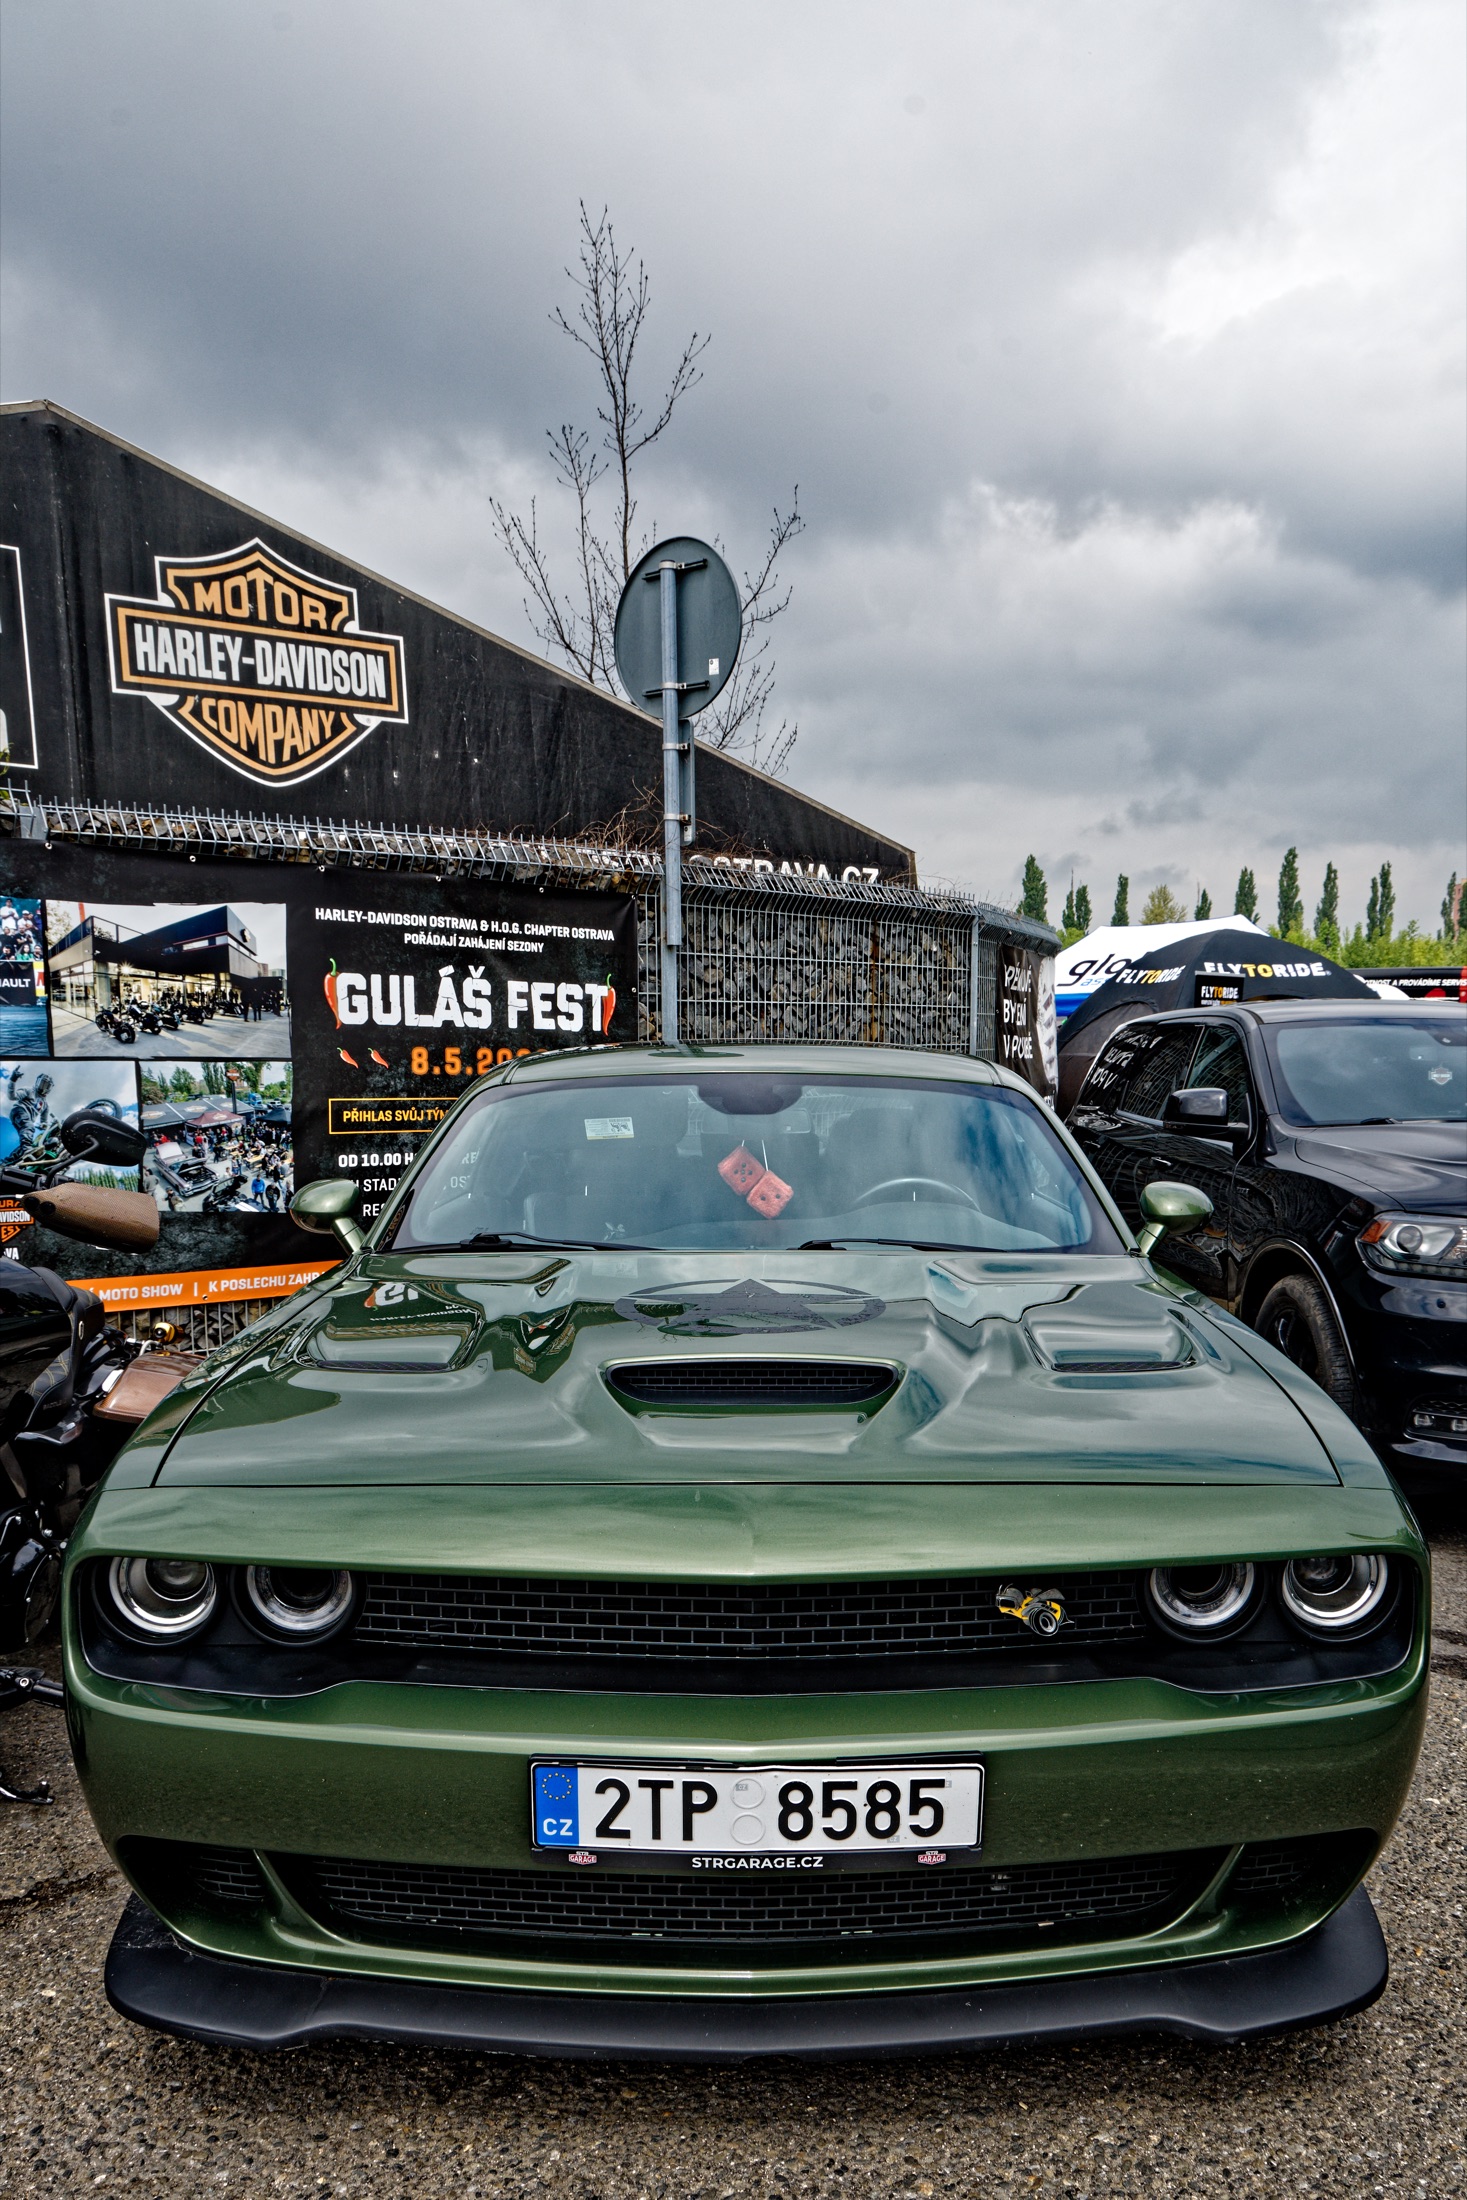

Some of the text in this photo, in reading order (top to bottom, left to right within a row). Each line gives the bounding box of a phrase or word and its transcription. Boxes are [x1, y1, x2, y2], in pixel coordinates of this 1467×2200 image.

[194, 568, 327, 630] MOTOR
[133, 623, 387, 698] HARLEY-DAVIDSON
[202, 698, 335, 764] COMPANY
[315, 907, 615, 941] HARLEY-DAVIDSON OSTRAVA & H.O.G. CHAPTER OSTRAVA
[404, 931, 544, 953] POŘÁDAJÍ ZAHÁJENÍ SEZONY
[1115, 965, 1186, 984] FLYTORIDE
[1203, 961, 1327, 978] FLYTORIDE
[336, 965, 608, 1031] GULÁŠ FEST
[1201, 985, 1239, 999] FLYTORIDE
[343, 1107, 392, 1122] PŘIHLAS
[395, 1107, 424, 1121] SVŮJ
[338, 1154, 358, 1168] OD
[361, 1152, 402, 1167] 10.00
[99, 1287, 139, 1301] MOTO
[141, 1283, 183, 1298] SHOW
[209, 1281, 218, 1292] K
[220, 1275, 286, 1292] POSLECHU
[594, 1778, 946, 1841] 2TP 8585
[543, 1818, 573, 1837] CZ
[569, 1855, 597, 1863] GARAGE
[692, 1856, 823, 1869] STRGARAGE.CZ
[918, 1855, 946, 1863] GARAGE
